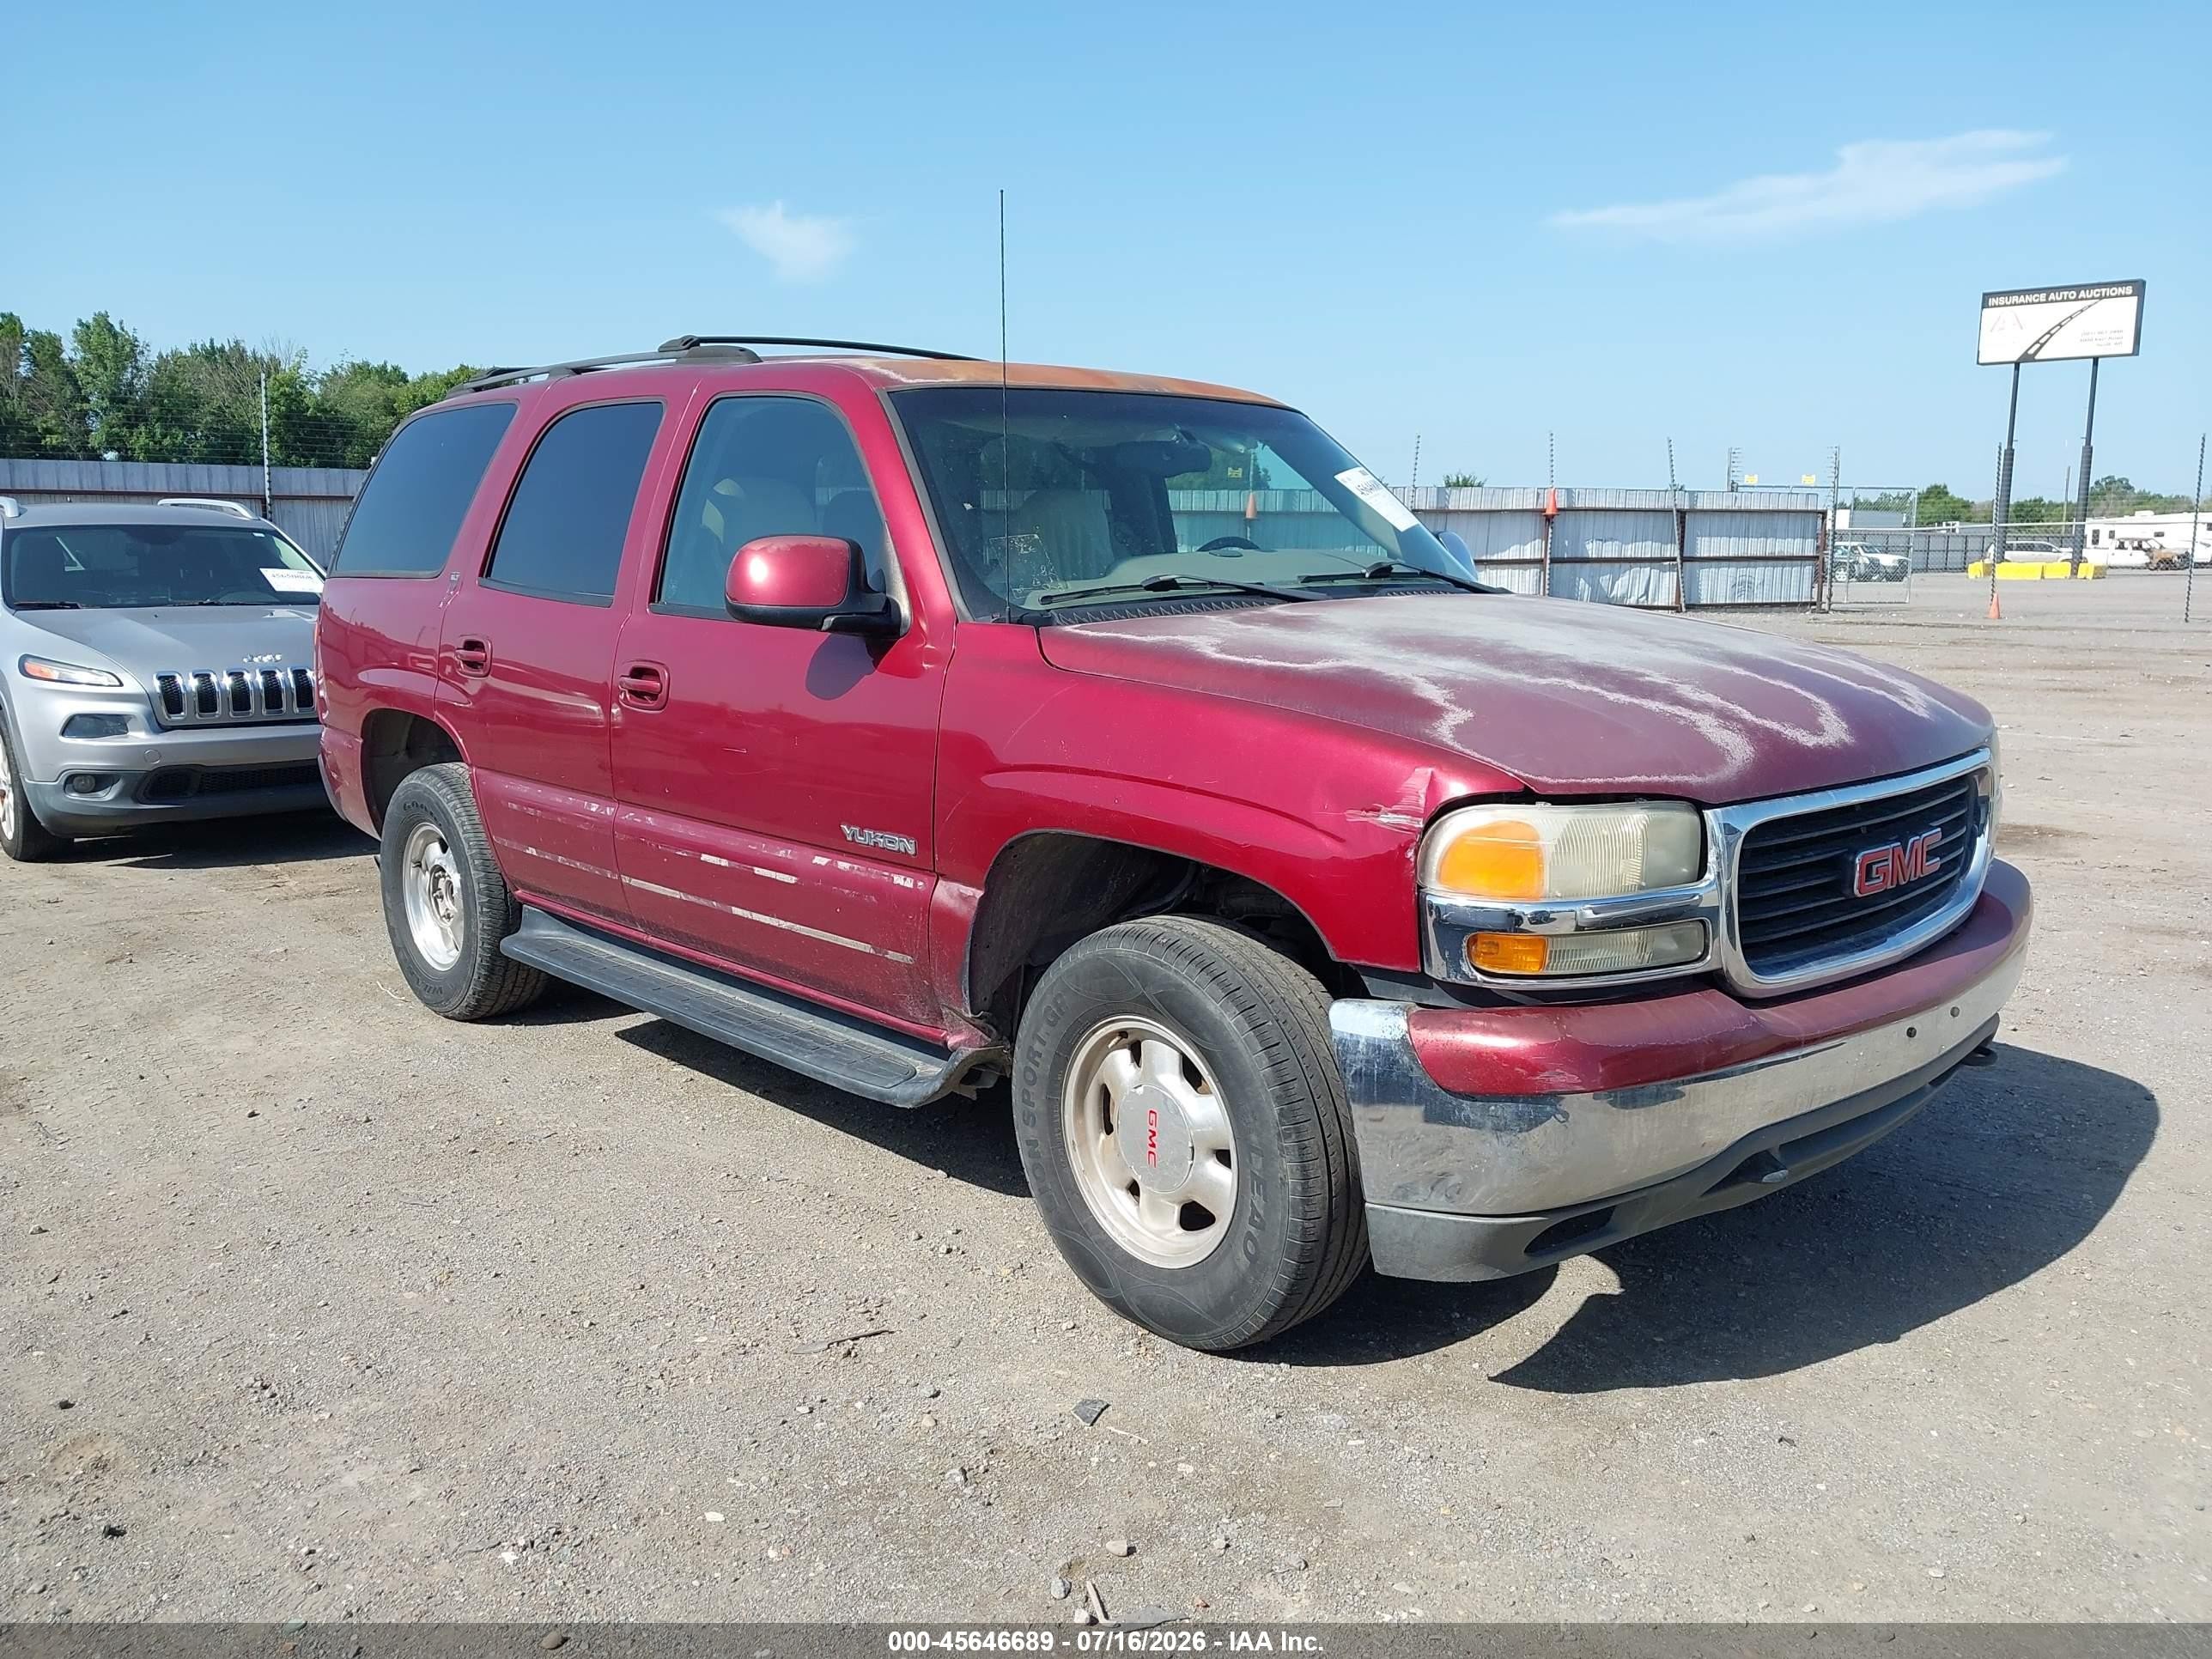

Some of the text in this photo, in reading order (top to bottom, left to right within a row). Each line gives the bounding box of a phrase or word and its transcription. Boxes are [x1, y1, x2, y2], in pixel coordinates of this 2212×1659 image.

[1988, 286, 2133, 307] INSURANCE AUTO AUCTIONS
[841, 824, 917, 855] YUKON
[1854, 827, 1942, 897] GMC
[1022, 1032, 1047, 1128] SPORT
[1147, 1109, 1158, 1169] GMC
